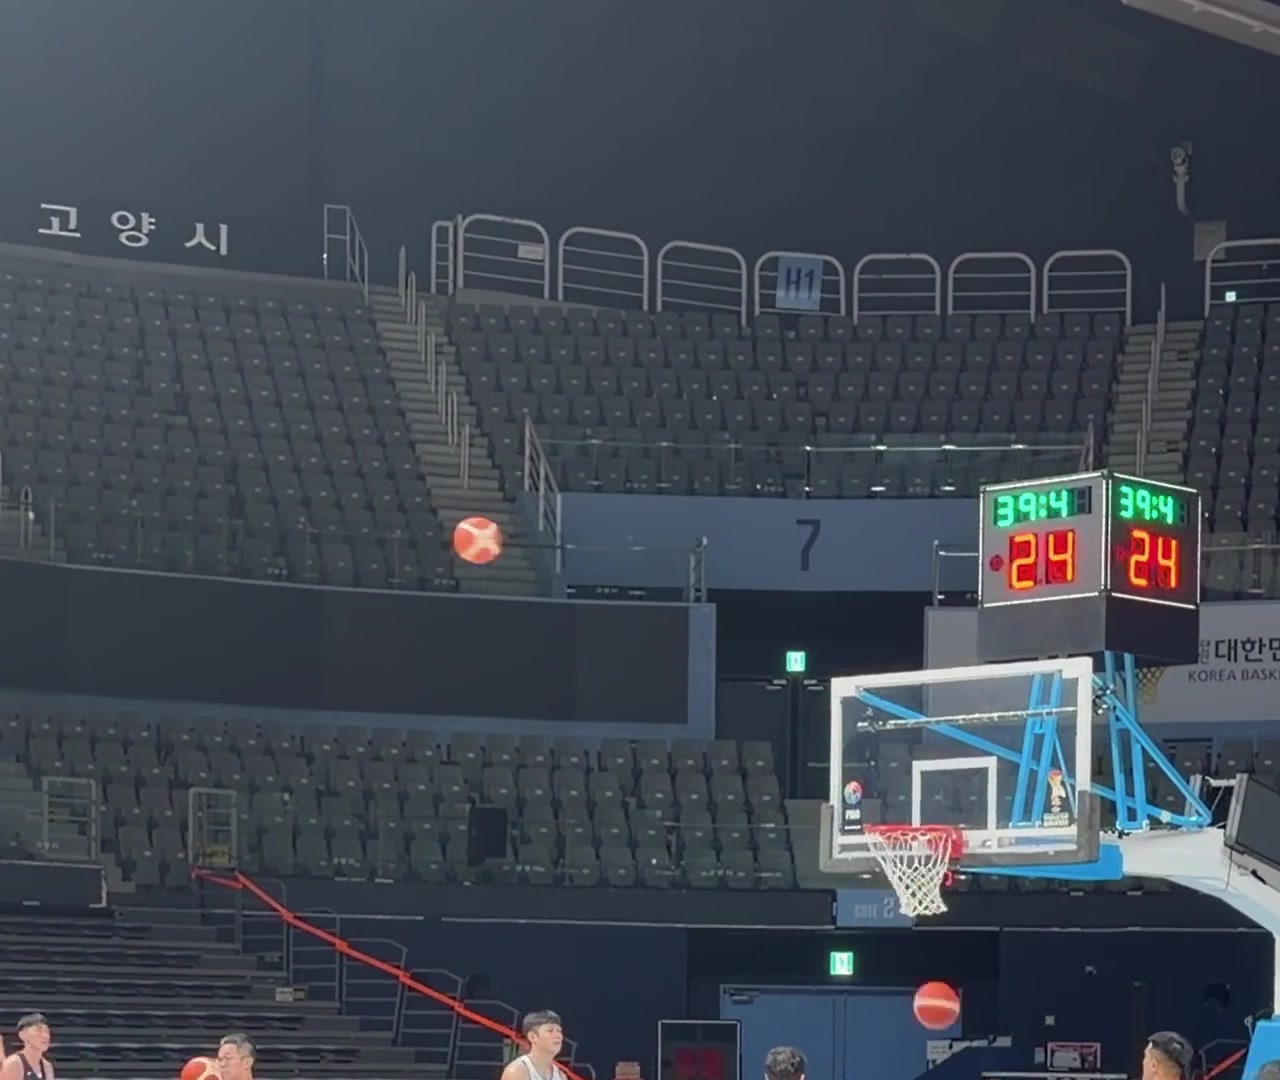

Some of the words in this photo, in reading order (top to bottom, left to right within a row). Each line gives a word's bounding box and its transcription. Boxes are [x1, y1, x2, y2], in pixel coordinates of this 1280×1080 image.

[786, 267, 814, 300] H1
[796, 519, 821, 571] 7
[1011, 531, 1074, 589] 24
[1129, 529, 1177, 589] 24
[1188, 668, 1237, 683] KOREA
